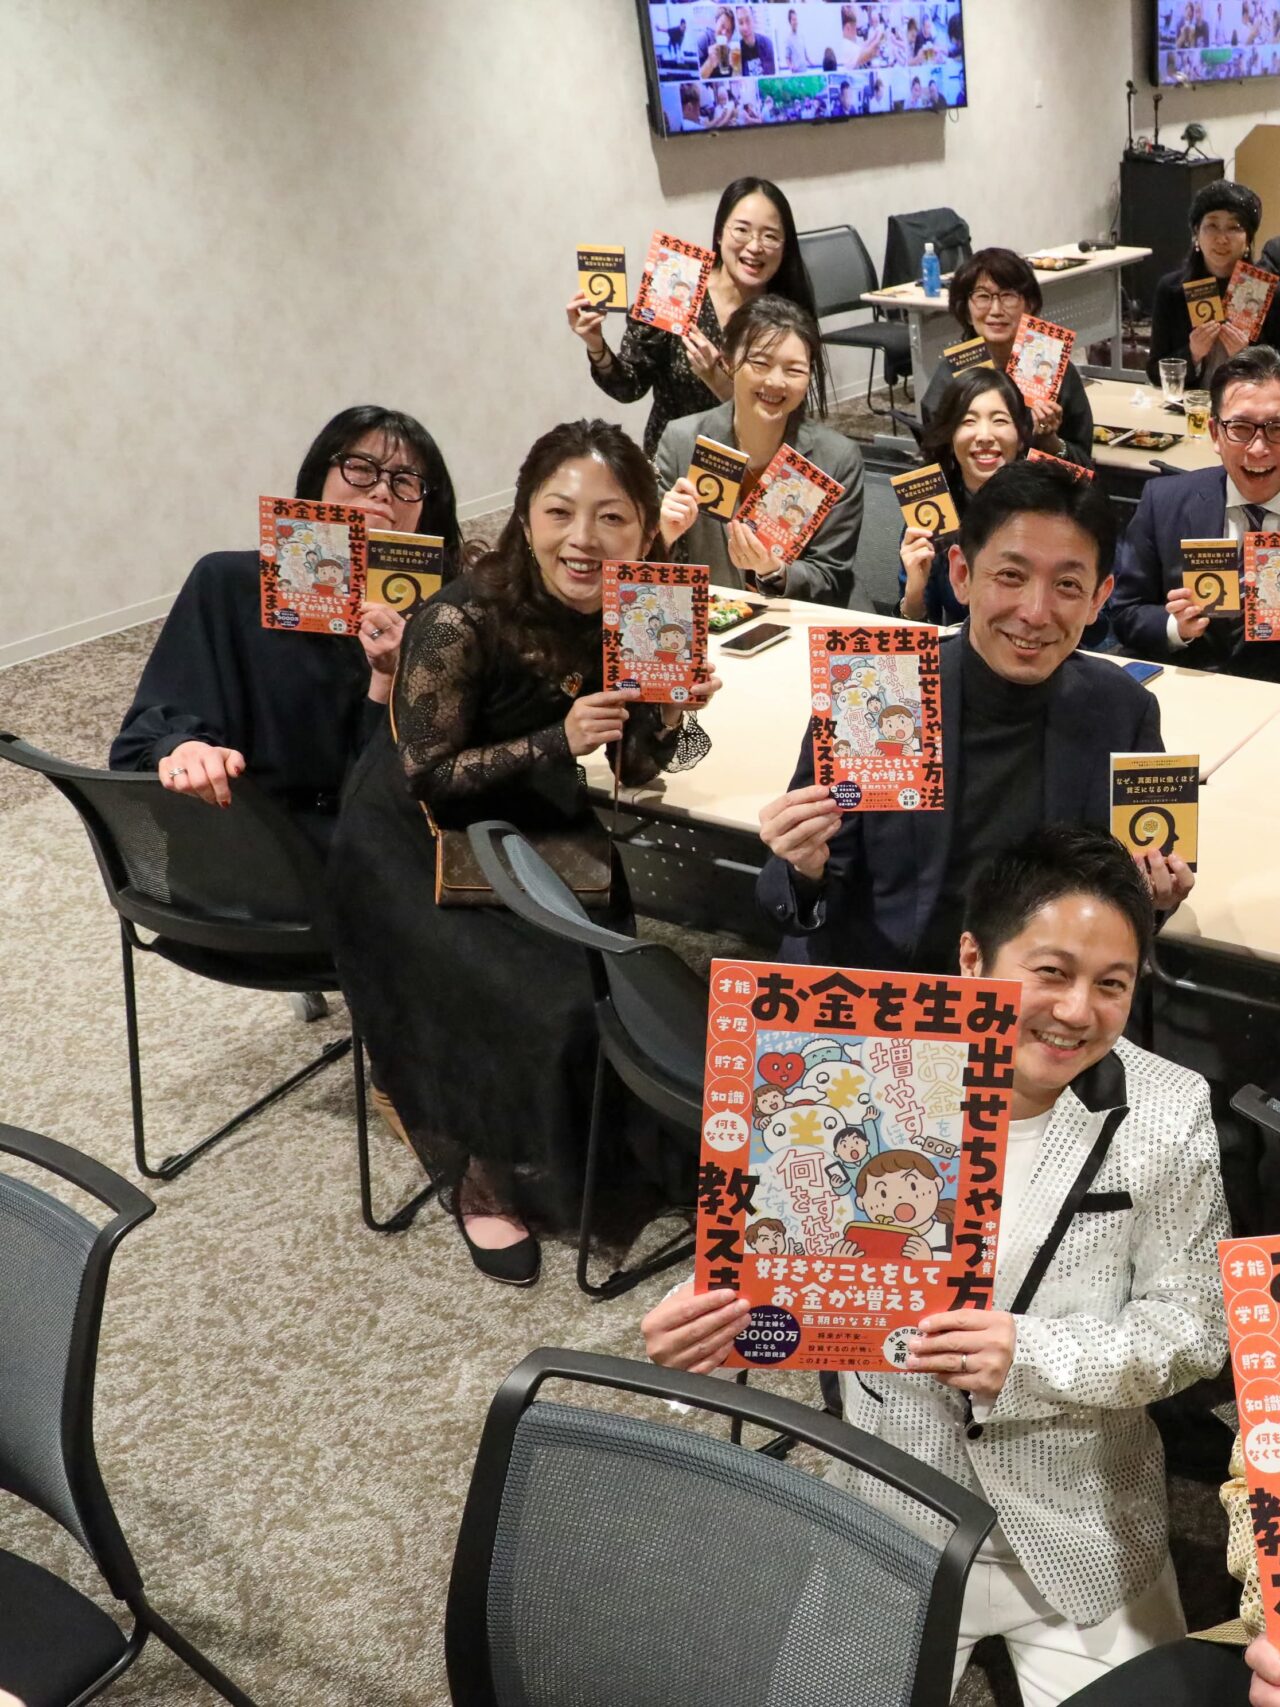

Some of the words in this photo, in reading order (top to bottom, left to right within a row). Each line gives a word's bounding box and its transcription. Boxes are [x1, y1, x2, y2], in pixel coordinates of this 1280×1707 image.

[826, 627, 938, 653] お金を生み
[918, 651, 944, 808] 出せちゃう方法
[812, 715, 838, 786] 教えま
[719, 979, 751, 995] 才能
[752, 971, 1018, 1035] お金を生み
[716, 1016, 749, 1033] 学歴
[714, 1055, 747, 1071] 貯金
[710, 1090, 745, 1105] 知識
[714, 1119, 738, 1130] 何も
[706, 1131, 745, 1143] なくても
[945, 1036, 1016, 1311] 出せちゃう方
[698, 1161, 761, 1291] 教えま
[755, 1257, 941, 1286] 好きなことをして
[1229, 1260, 1267, 1278] 才能
[770, 1281, 926, 1312] お金が増える
[751, 1312, 793, 1321] ラリーマンも
[802, 1313, 888, 1327] 画期的な方法
[1234, 1304, 1271, 1325] 学歴
[1241, 1350, 1277, 1371] 貯金
